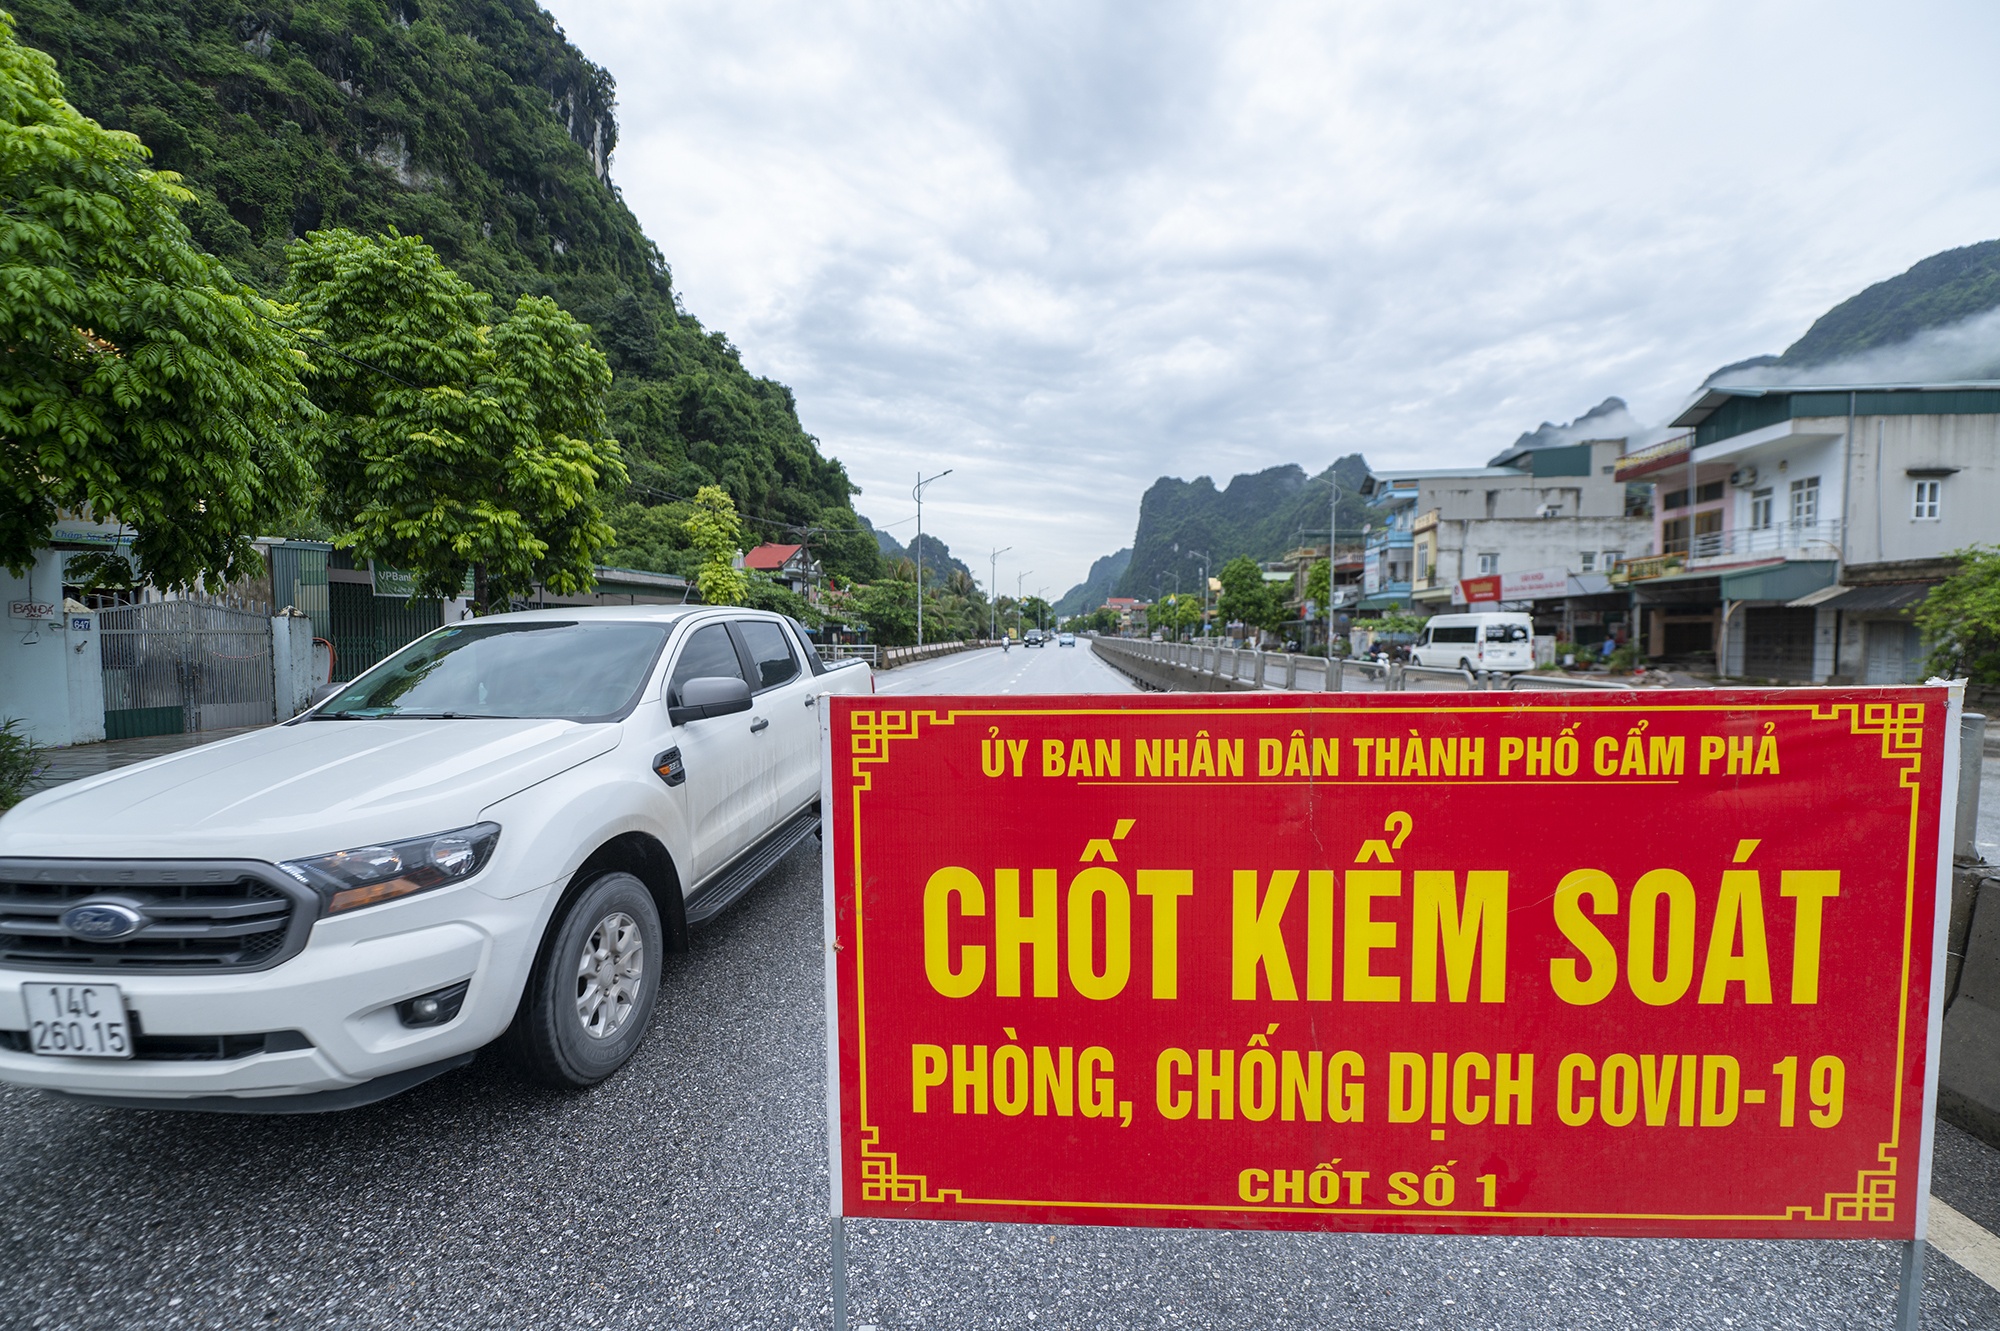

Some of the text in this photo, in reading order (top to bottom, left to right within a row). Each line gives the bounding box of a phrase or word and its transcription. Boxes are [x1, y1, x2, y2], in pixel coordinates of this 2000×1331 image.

[73, 620, 89, 630] 647
[982, 719, 1780, 777] ỦY BAN NHÂN DÂN THÀNH PHỐ CẨM PHẢ
[74, 911, 116, 933] Ford
[923, 810, 1841, 1006] CHỐT KIỂM SOÁT
[49, 987, 101, 1018] 14C
[33, 1021, 125, 1053] 260.15
[912, 1023, 1846, 1141] PHÒNG, CHỐNG DỊCH COVID-19
[1239, 1158, 1497, 1208] CHỐT SỐ 1
